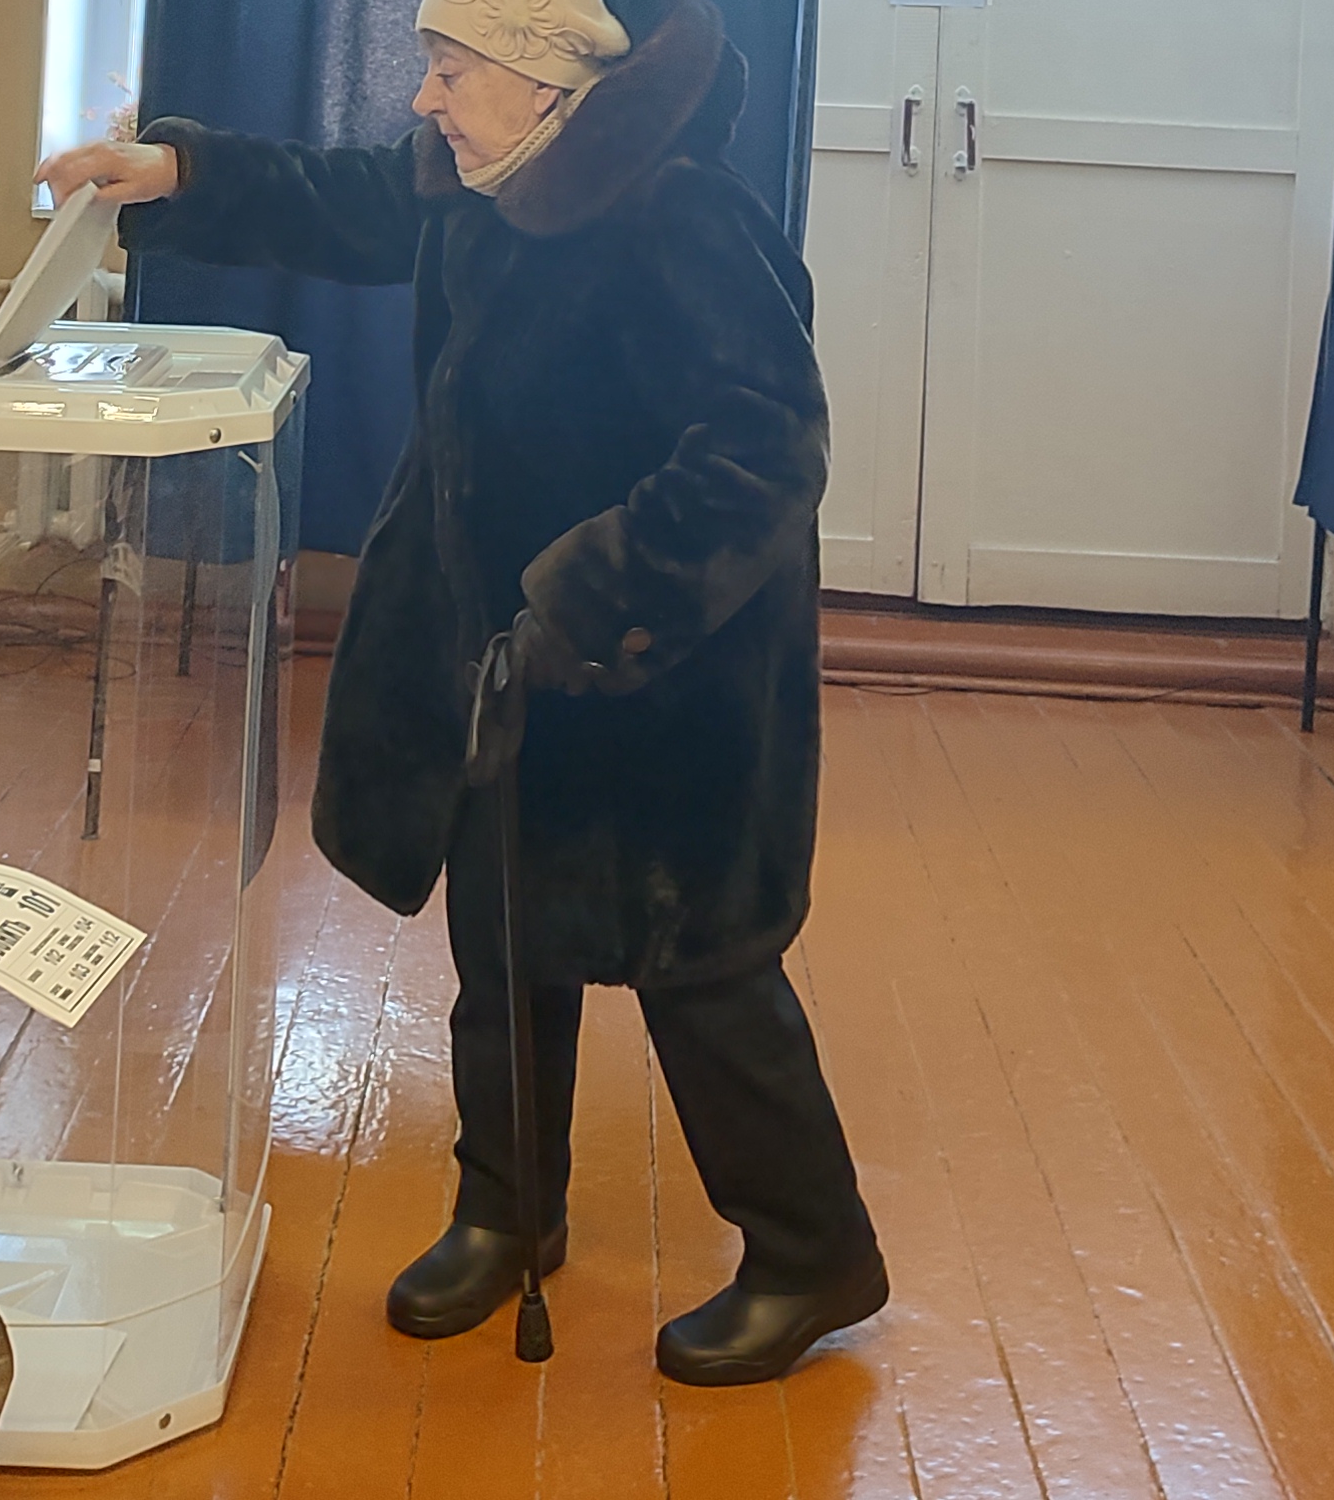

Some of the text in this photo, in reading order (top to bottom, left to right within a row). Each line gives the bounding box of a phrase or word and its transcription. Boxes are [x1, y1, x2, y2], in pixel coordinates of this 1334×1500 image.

[17, 888, 62, 918] 101
[98, 930, 121, 948] 112
[43, 948, 66, 966] 102
